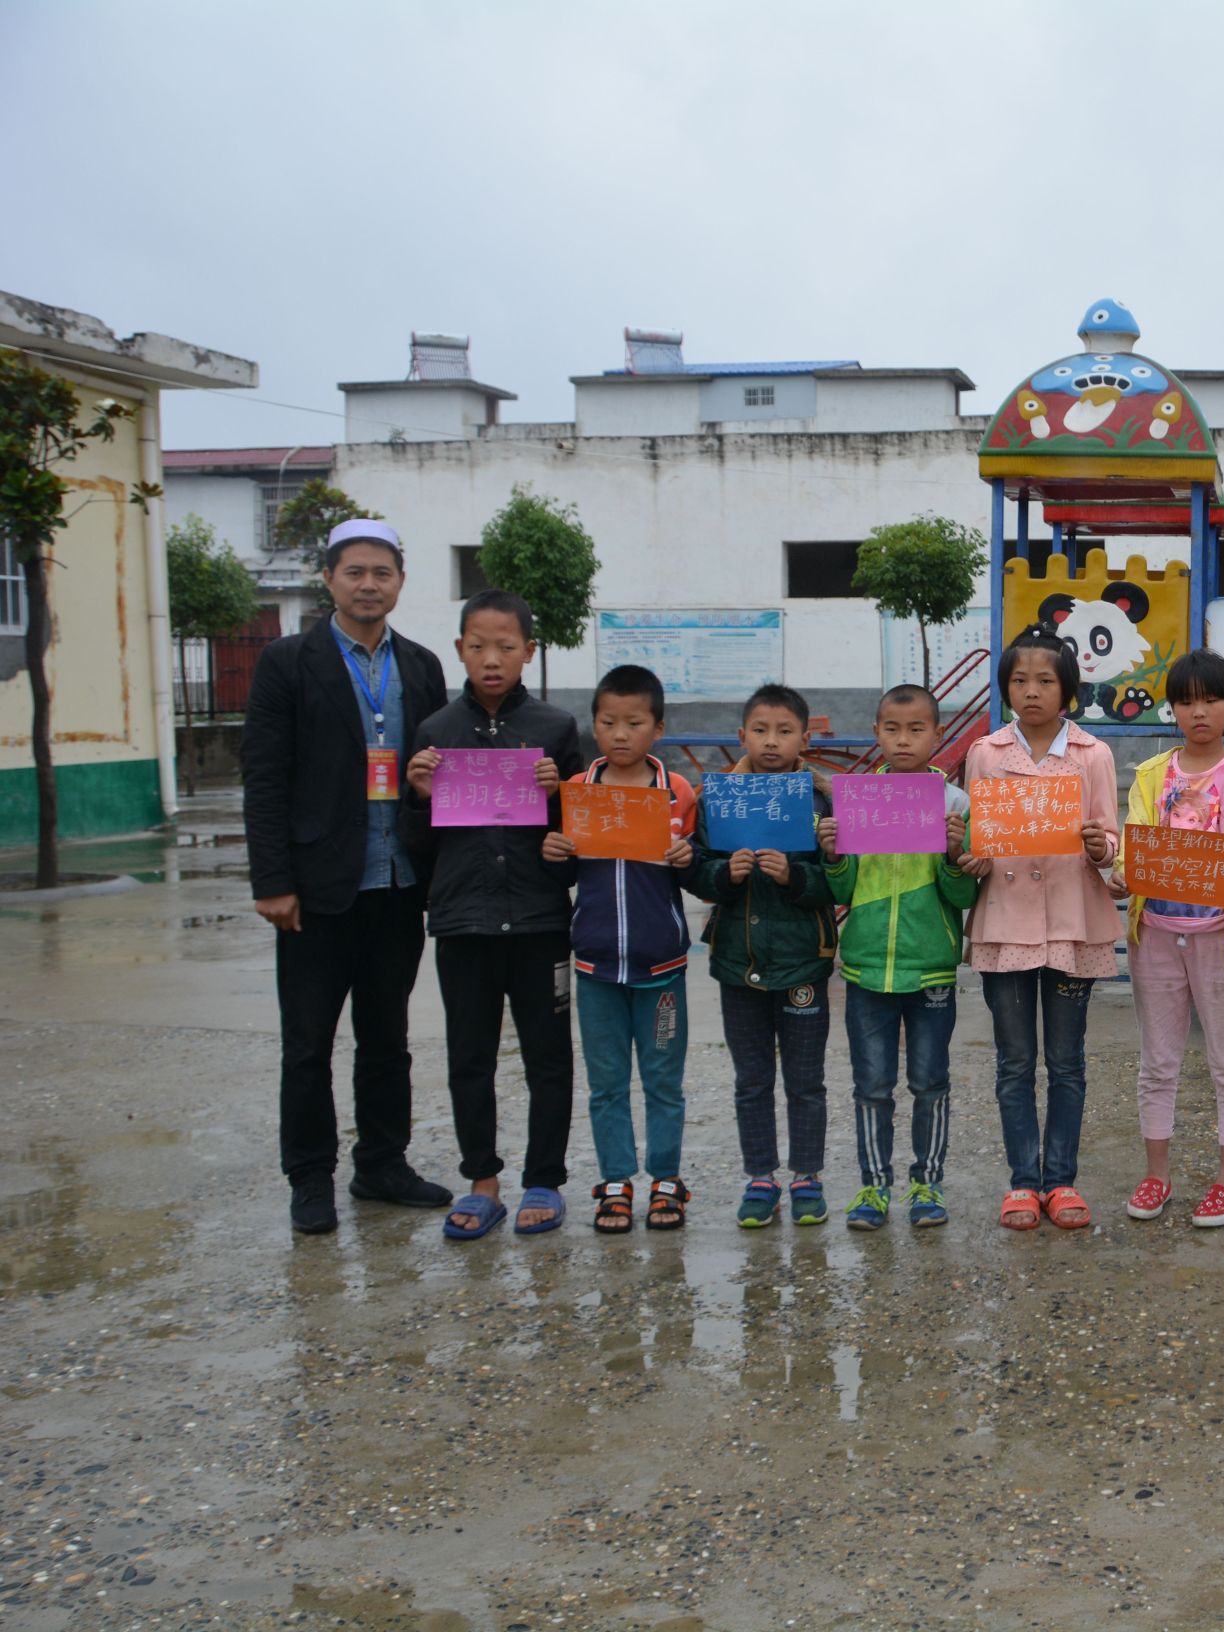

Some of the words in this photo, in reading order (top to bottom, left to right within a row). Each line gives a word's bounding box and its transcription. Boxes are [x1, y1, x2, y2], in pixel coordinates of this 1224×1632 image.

[703, 774, 810, 799] 我想去雷锋
